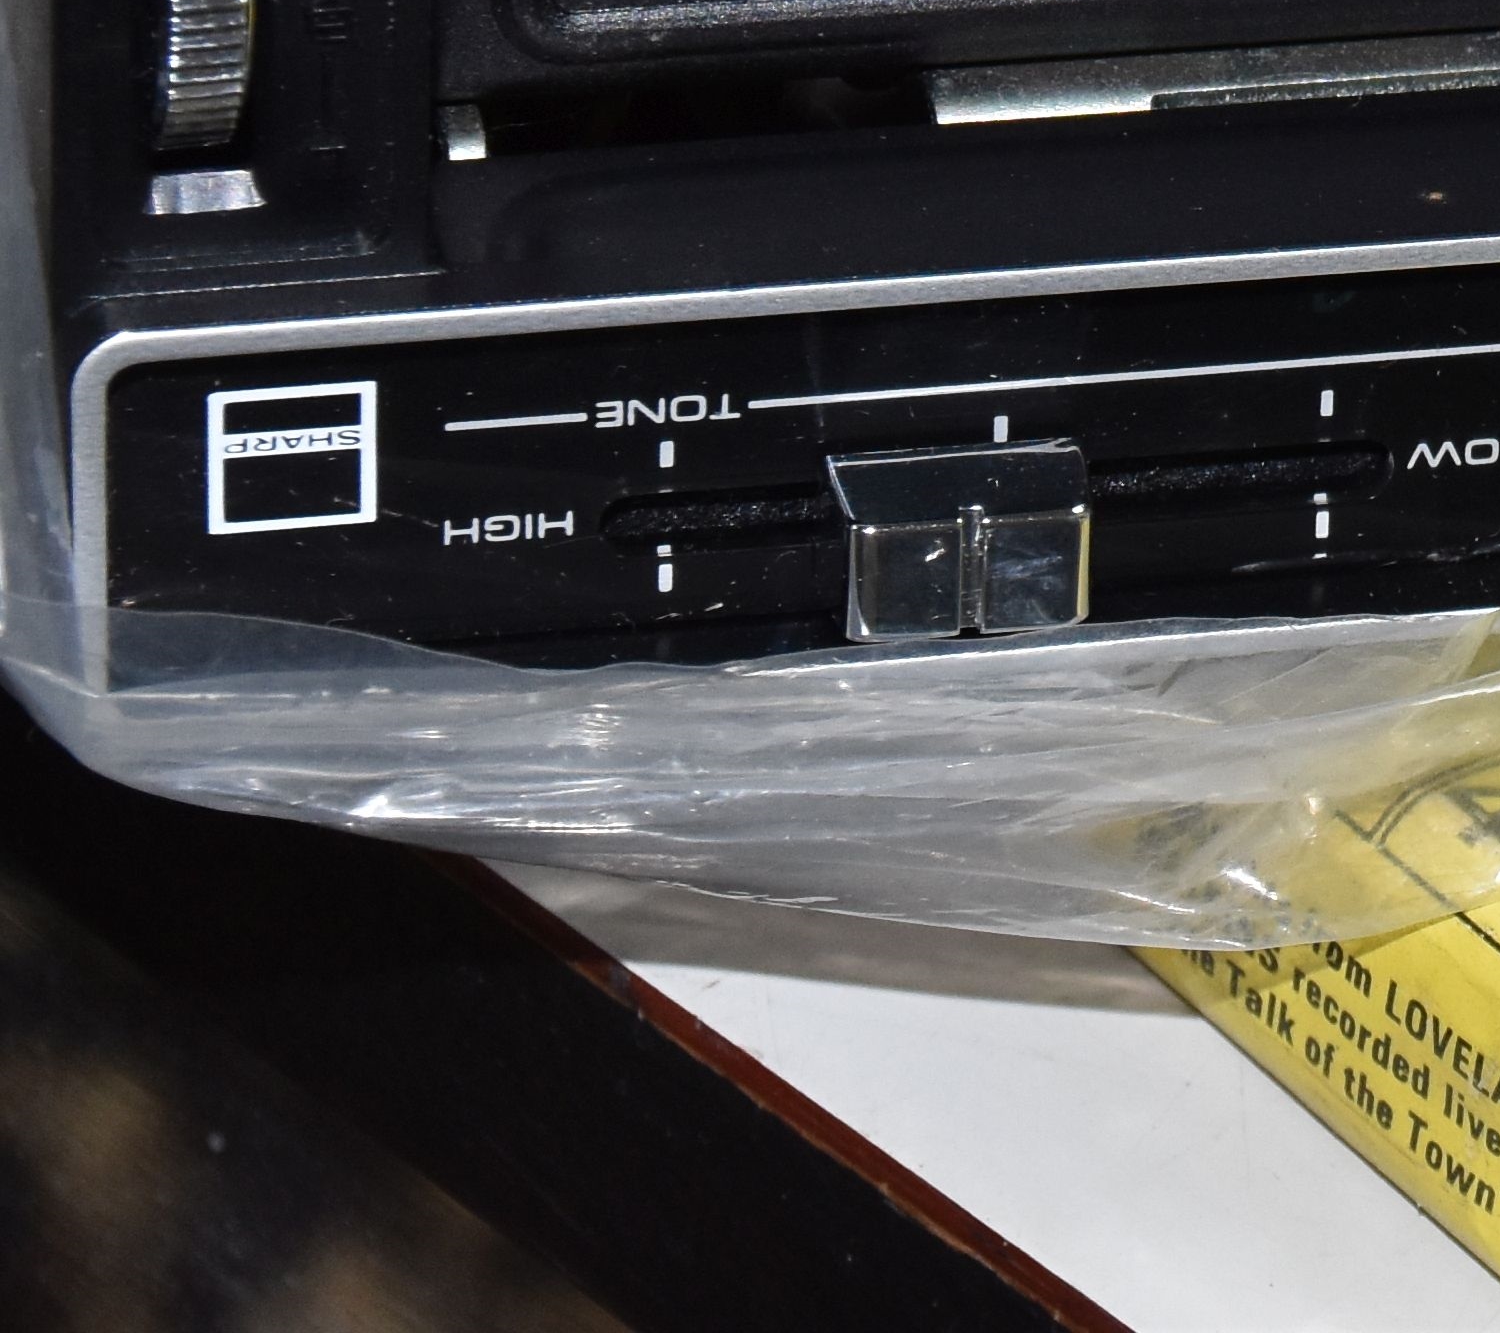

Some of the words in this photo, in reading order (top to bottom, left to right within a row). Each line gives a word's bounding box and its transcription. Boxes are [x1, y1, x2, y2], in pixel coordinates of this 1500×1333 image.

[594, 393, 744, 431] TONE
[225, 430, 362, 455] SHARP
[443, 510, 576, 546] HIGH
[1312, 941, 1371, 996] om
[1183, 950, 1215, 977] he
[1225, 958, 1294, 1041] Talk
[1305, 1037, 1335, 1077] of
[1345, 1069, 1393, 1130] the
[1292, 967, 1430, 1099] recorded
